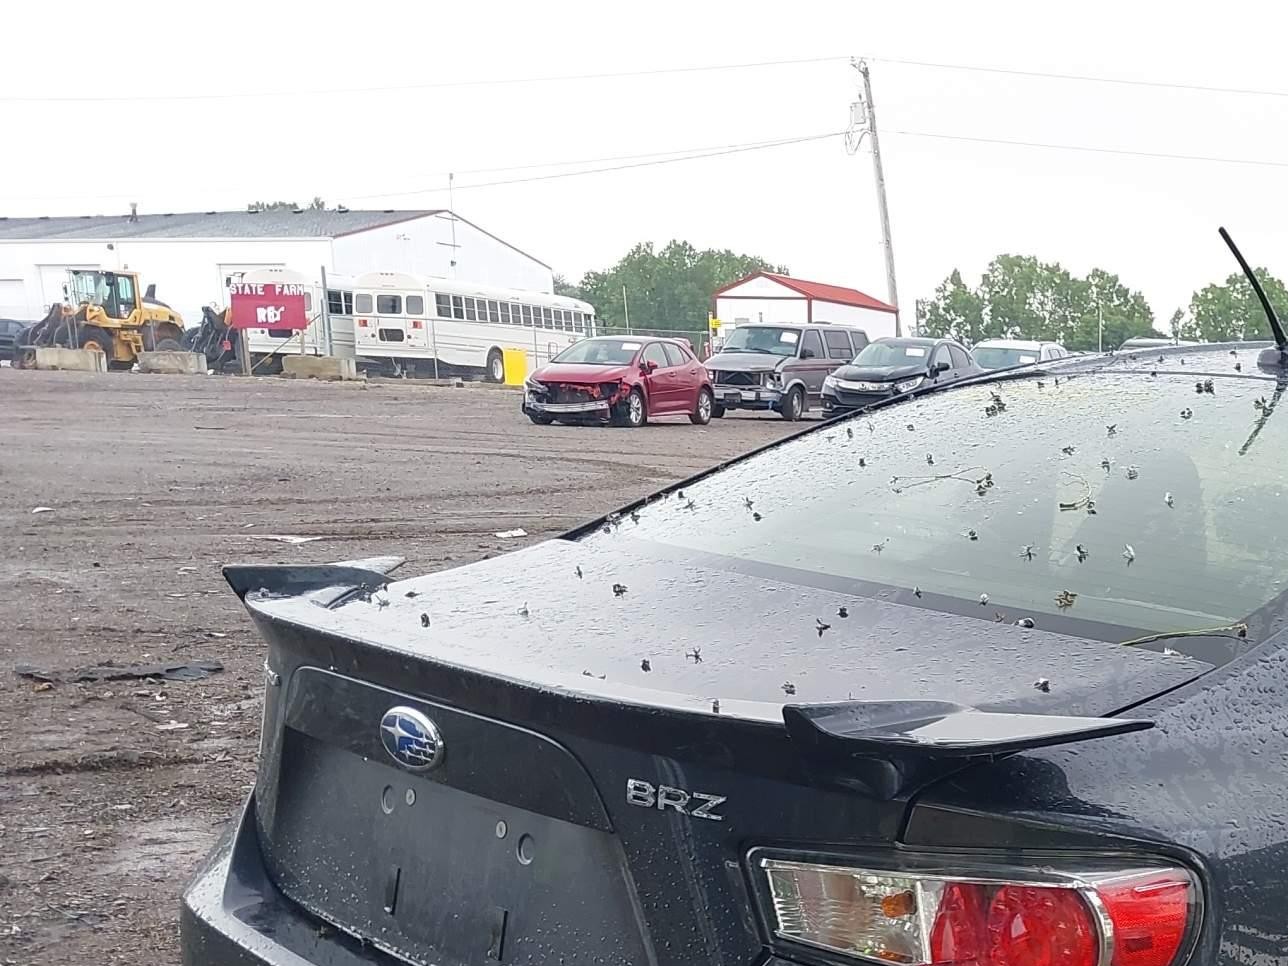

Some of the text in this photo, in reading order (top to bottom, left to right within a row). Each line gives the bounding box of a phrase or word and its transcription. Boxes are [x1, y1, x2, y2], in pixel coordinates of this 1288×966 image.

[230, 284, 304, 296] STATE FARM
[626, 778, 727, 820] BRZ
